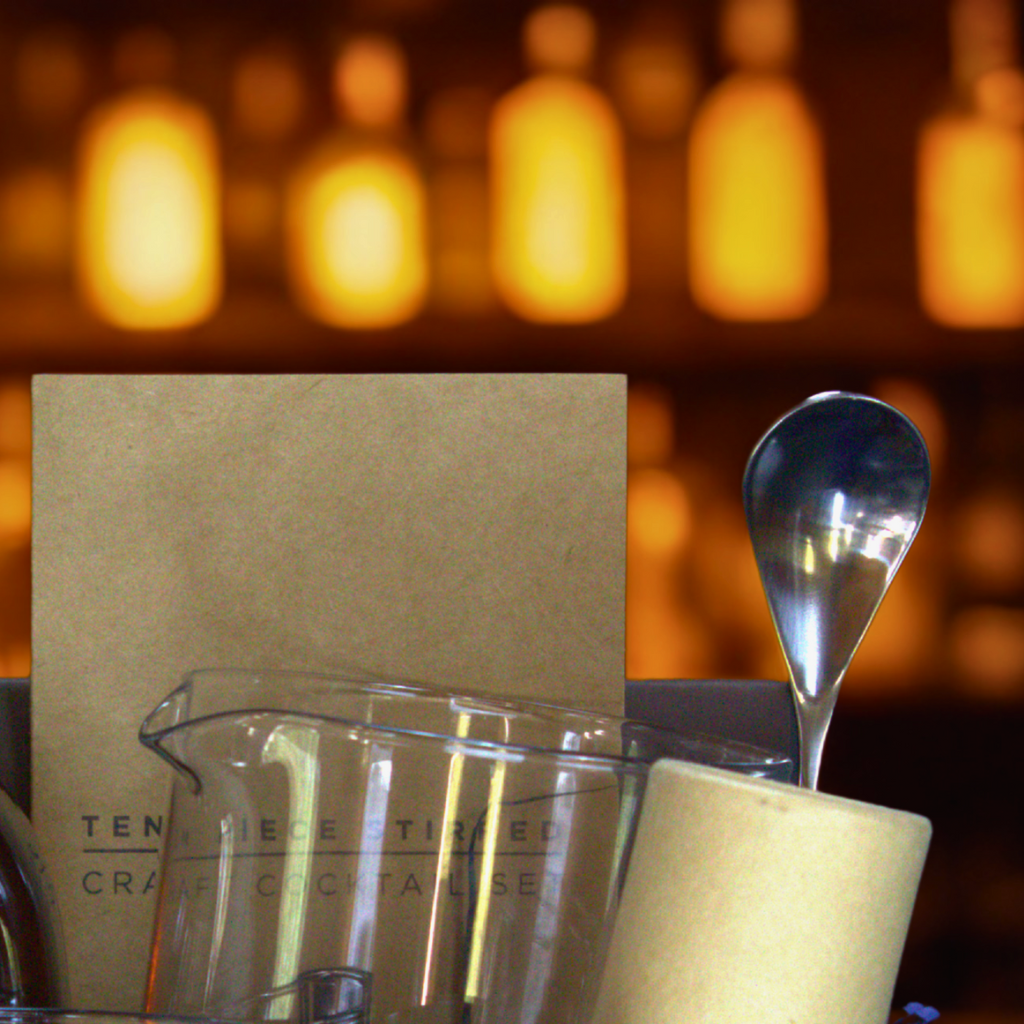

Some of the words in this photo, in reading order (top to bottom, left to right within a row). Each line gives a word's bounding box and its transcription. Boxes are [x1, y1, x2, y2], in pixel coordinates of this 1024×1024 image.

[81, 815, 163, 837] TEN
[219, 818, 336, 843] IECE
[82, 870, 234, 899] CRAF
